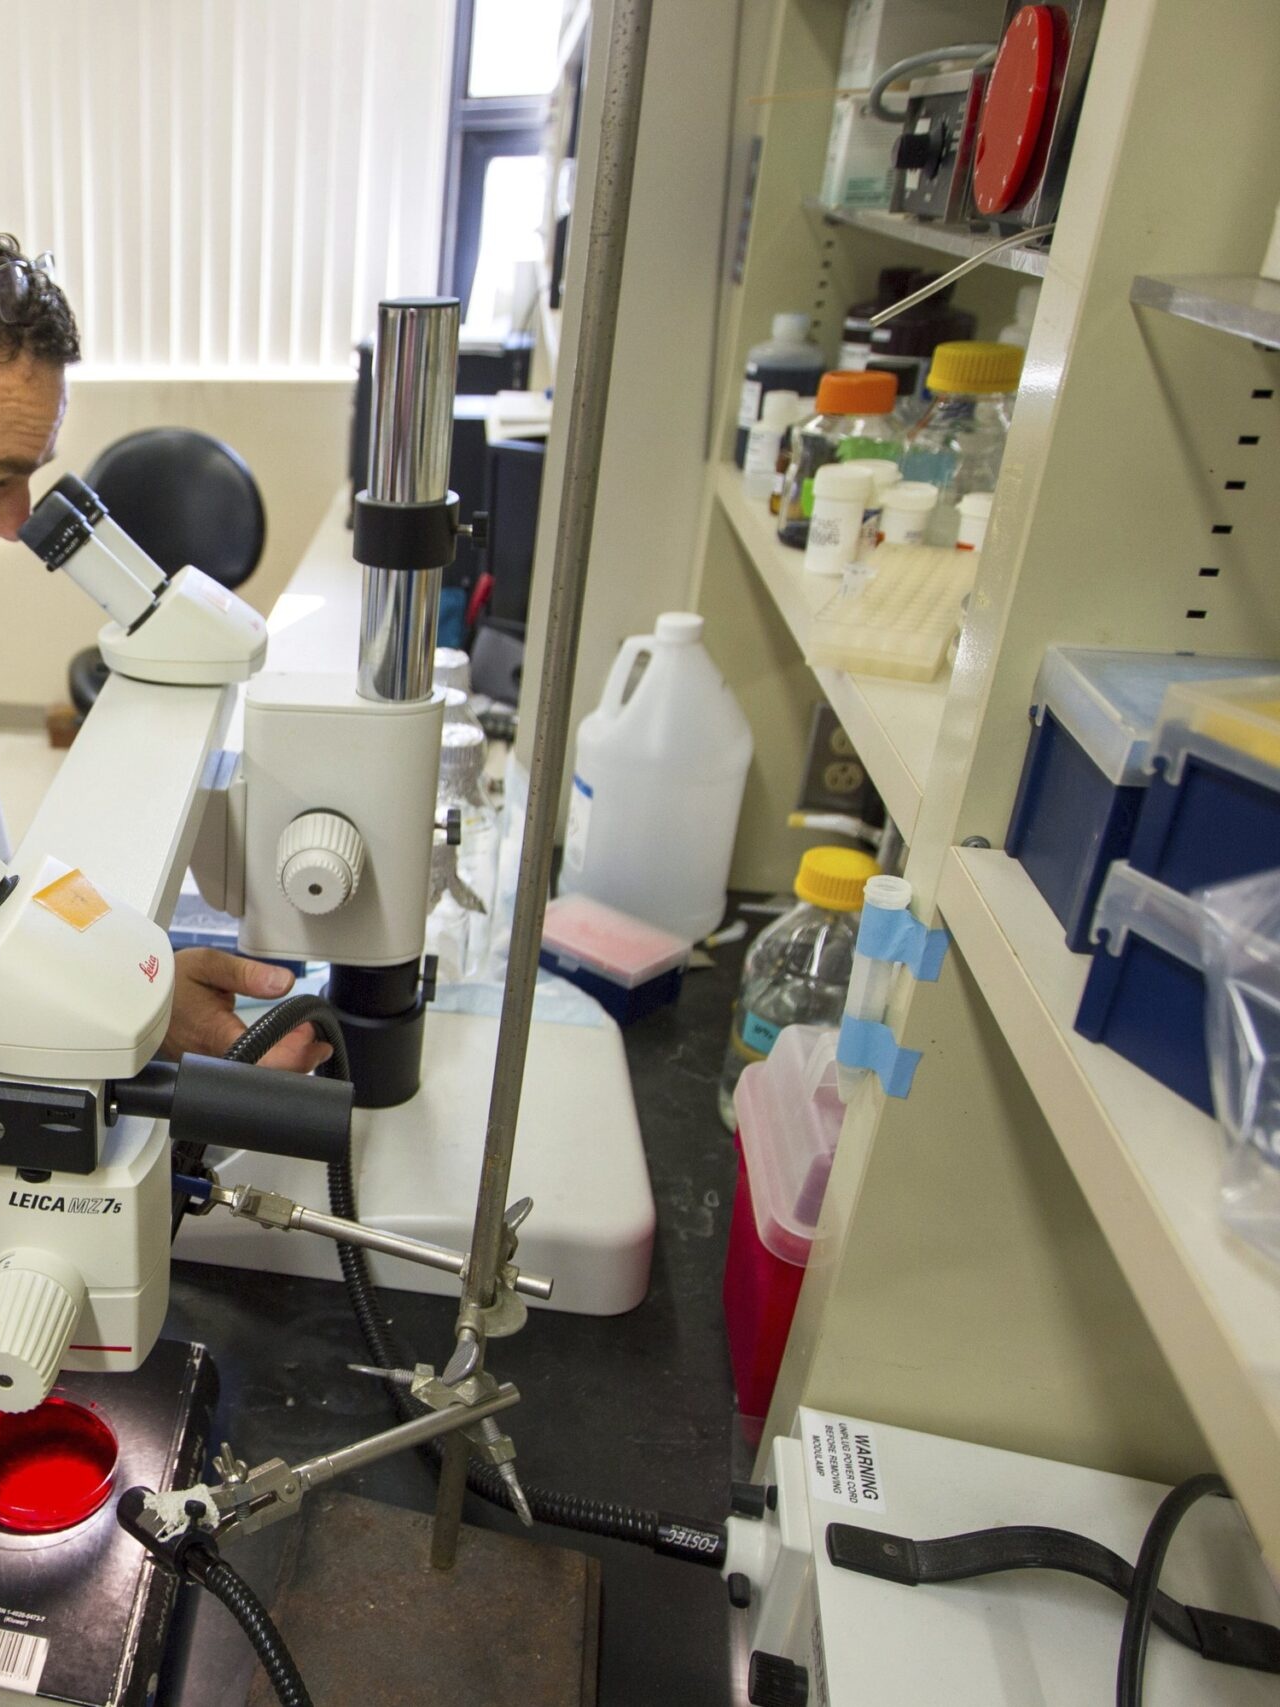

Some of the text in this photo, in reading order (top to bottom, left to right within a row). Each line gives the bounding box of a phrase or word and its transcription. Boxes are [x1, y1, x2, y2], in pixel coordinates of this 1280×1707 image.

[139, 954, 159, 983] Leica
[8, 1191, 65, 1213] LEICA
[812, 1434, 825, 1477] MODULAMP
[825, 1424, 842, 1494] BEFORE REMOVING
[839, 1422, 858, 1504] UNPLUG POWER CORD
[854, 1434, 879, 1501] WARNING
[665, 1529, 719, 1553] FOSTEC
